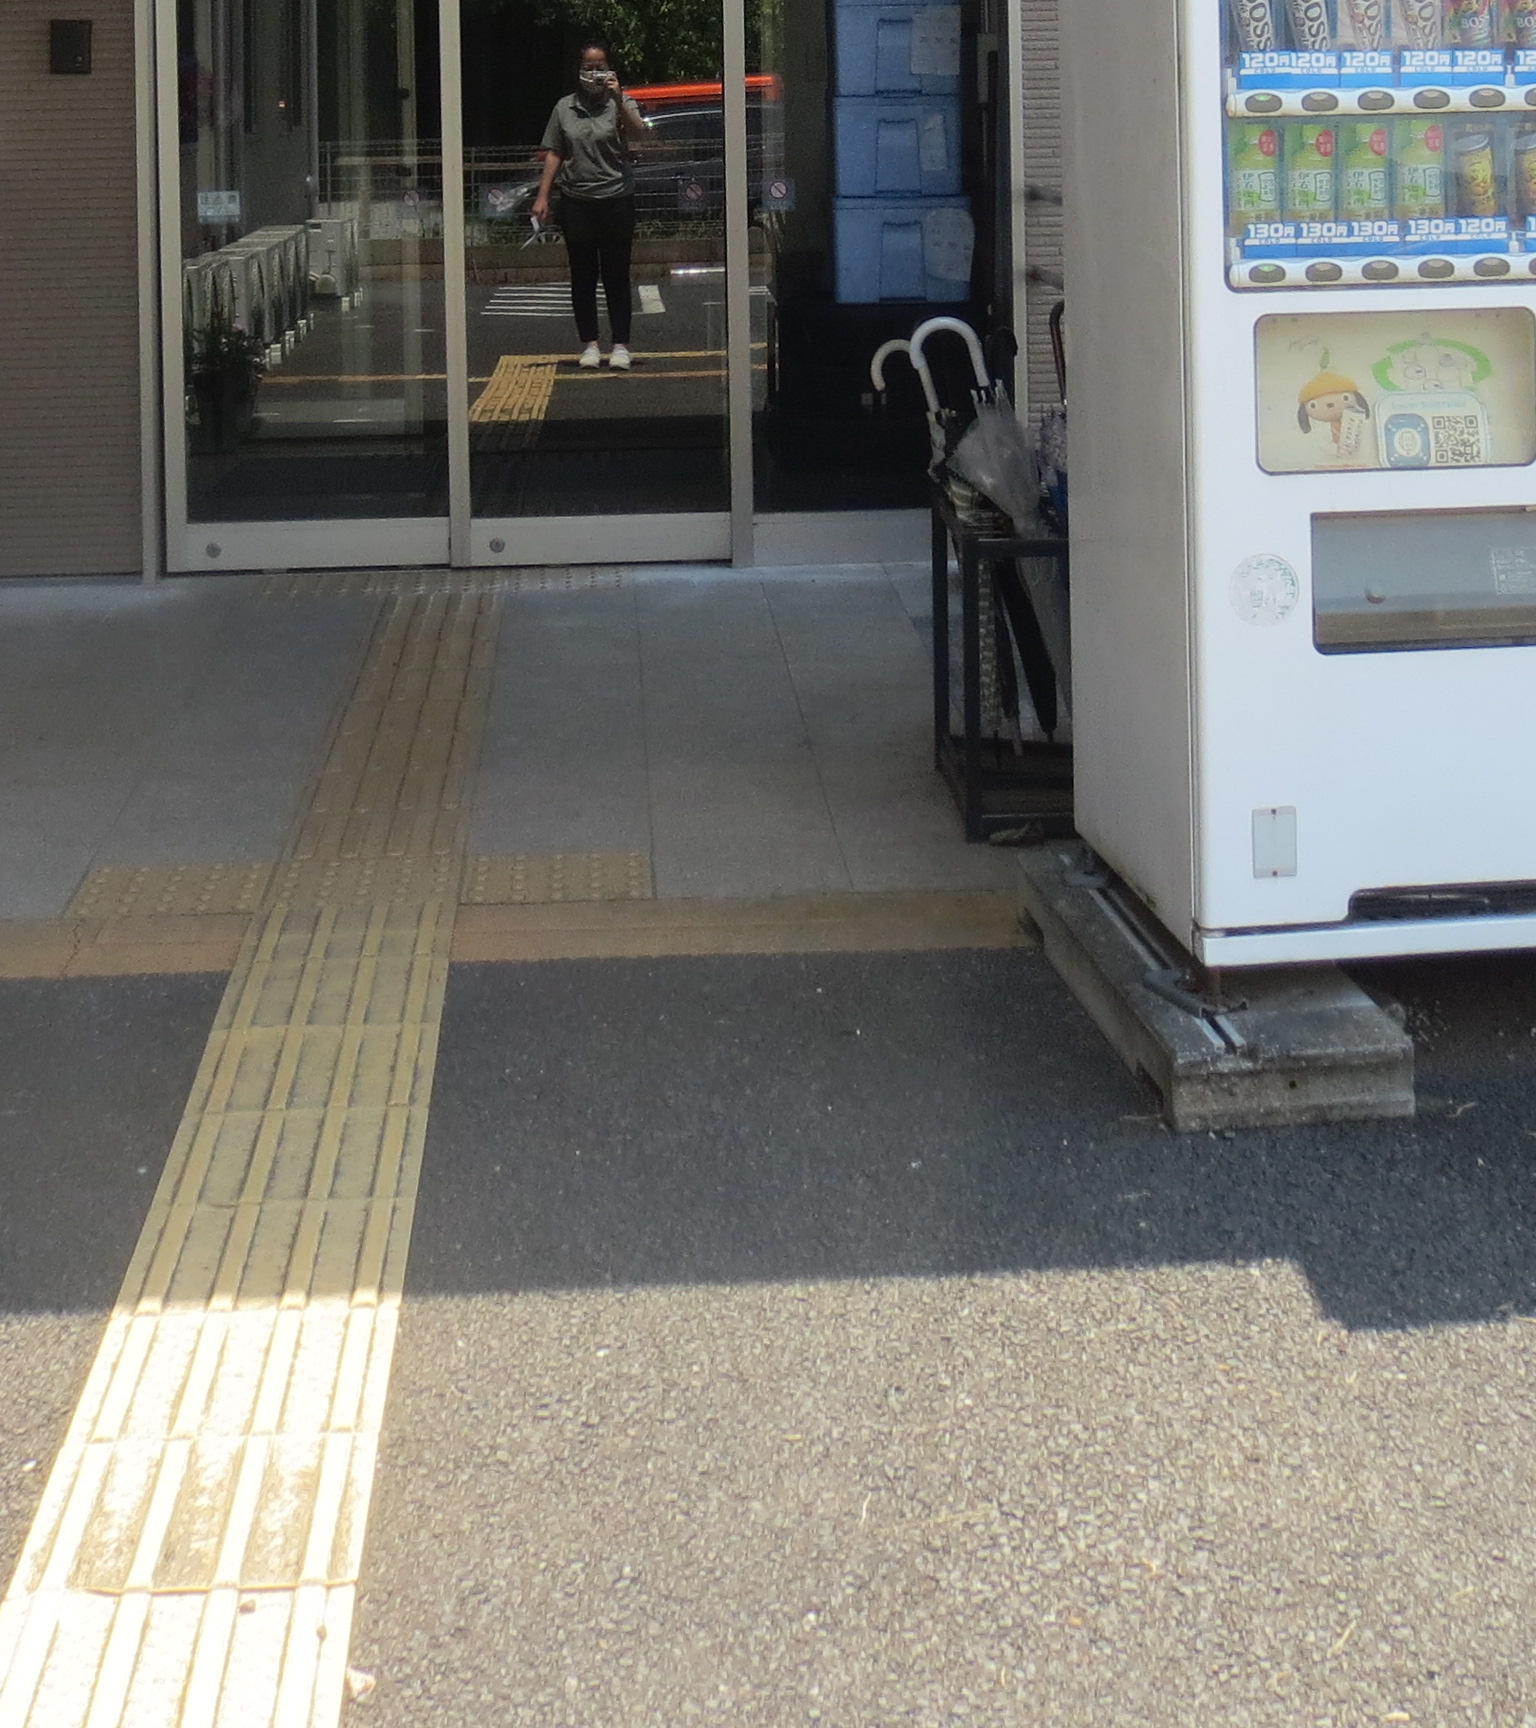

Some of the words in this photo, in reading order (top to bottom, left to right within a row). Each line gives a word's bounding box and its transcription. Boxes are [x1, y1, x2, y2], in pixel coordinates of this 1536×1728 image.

[1242, 53, 1290, 68] 120円
[1290, 52, 1336, 67] 120円
[1343, 52, 1390, 67] 120円
[1402, 51, 1450, 66] 120円
[1454, 51, 1502, 65] 120円
[1247, 223, 1295, 238] 130円
[1300, 223, 1347, 237] 130円
[1351, 221, 1399, 236] 130円
[1408, 220, 1455, 234] 130円
[1458, 218, 1506, 233] 120円
